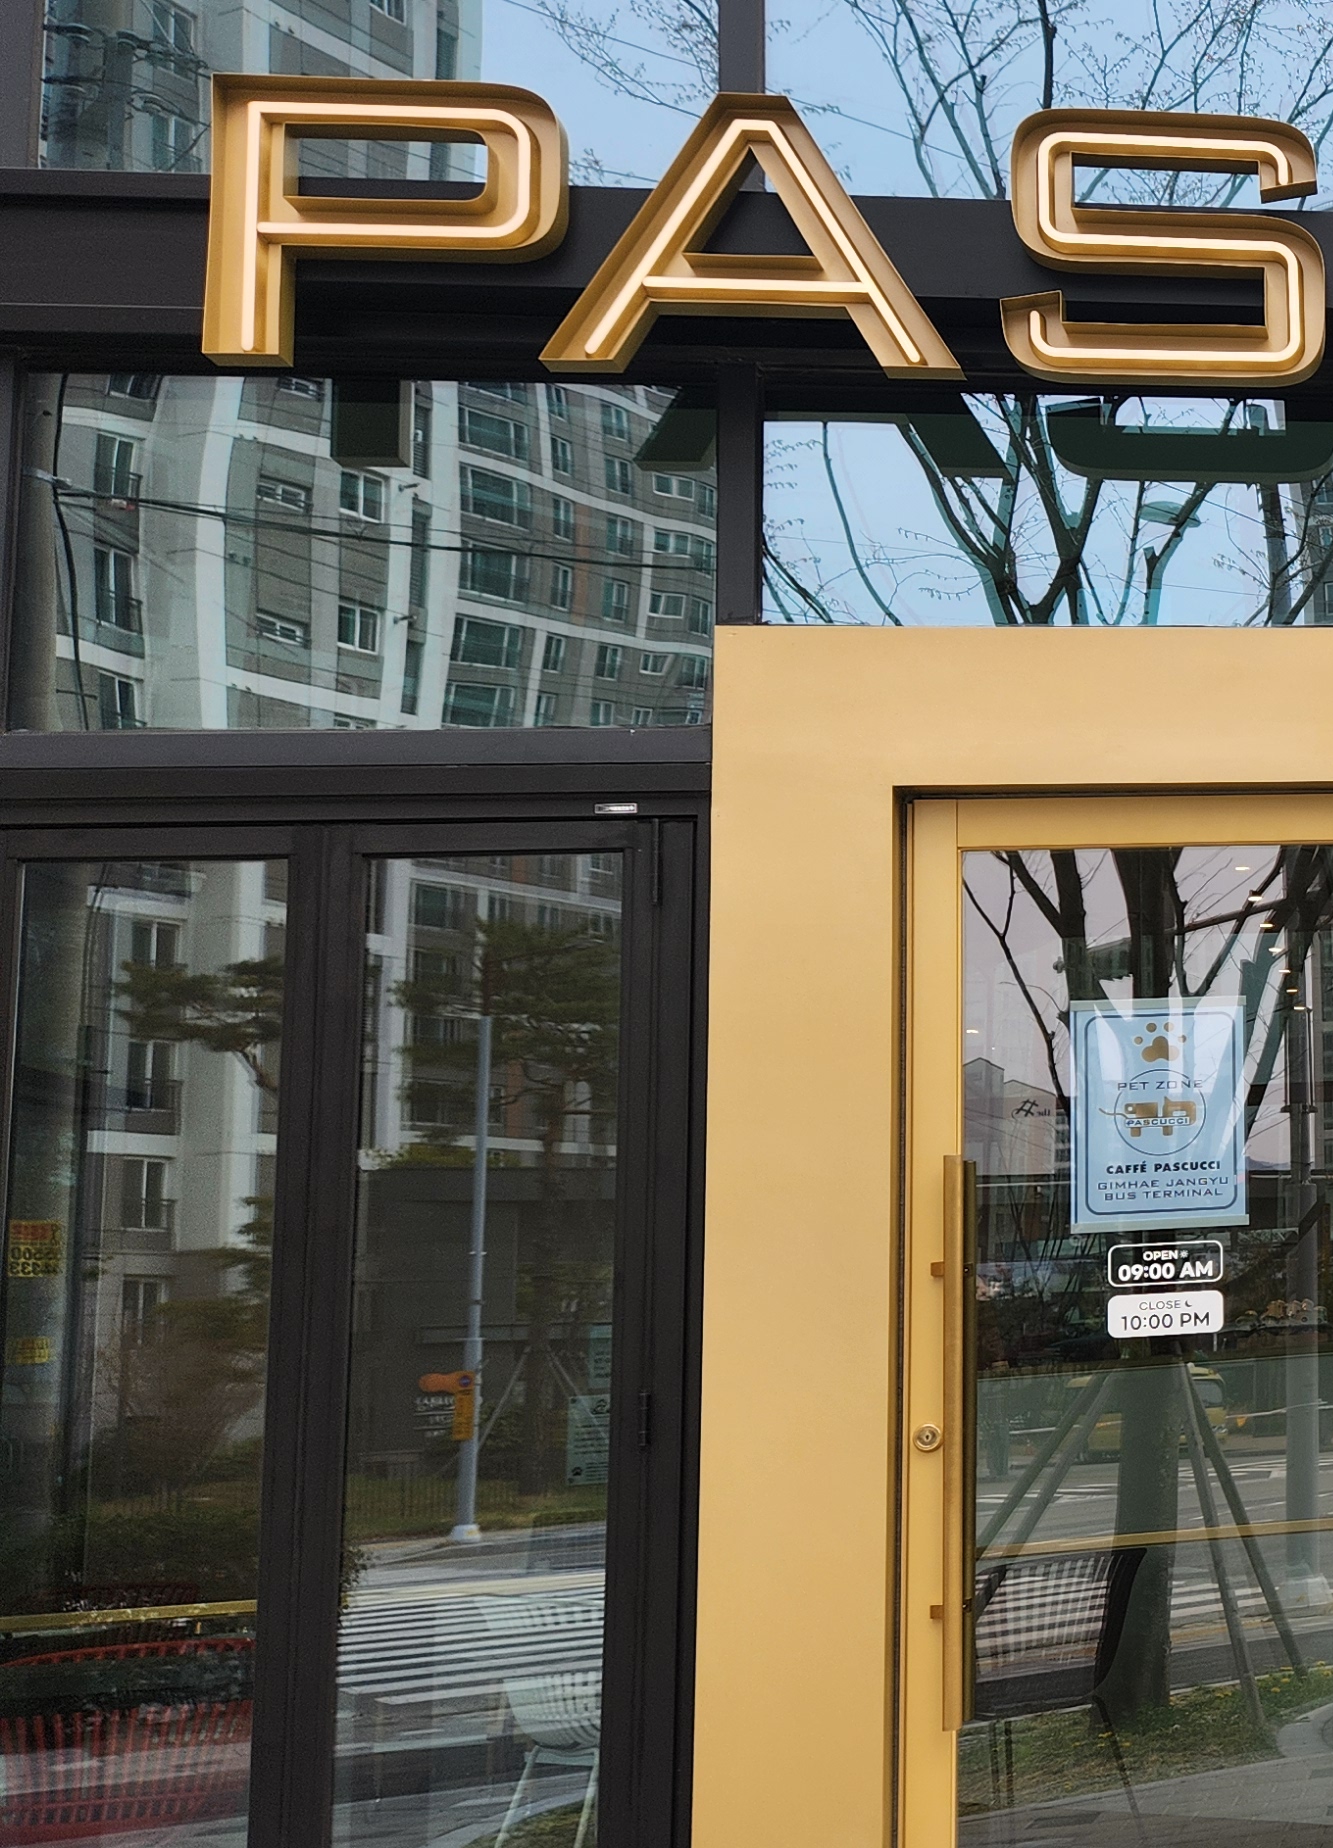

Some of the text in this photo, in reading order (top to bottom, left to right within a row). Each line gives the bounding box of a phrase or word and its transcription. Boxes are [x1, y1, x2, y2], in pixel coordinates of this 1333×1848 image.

[1117, 1079, 1204, 1091] PET ZONE
[1125, 1117, 1189, 1127] PASCUCCI
[1106, 1160, 1221, 1175] CAFFÉ PASCUCCI
[1098, 1176, 1229, 1191] GIMHAE JANGYU
[1104, 1188, 1223, 1201] BUS TERMINAL
[1142, 1249, 1179, 1261] OPEN
[1118, 1260, 1213, 1281] 09:00 AM
[1138, 1300, 1182, 1311] CLOSE
[1120, 1311, 1210, 1331] 10:00 PM
